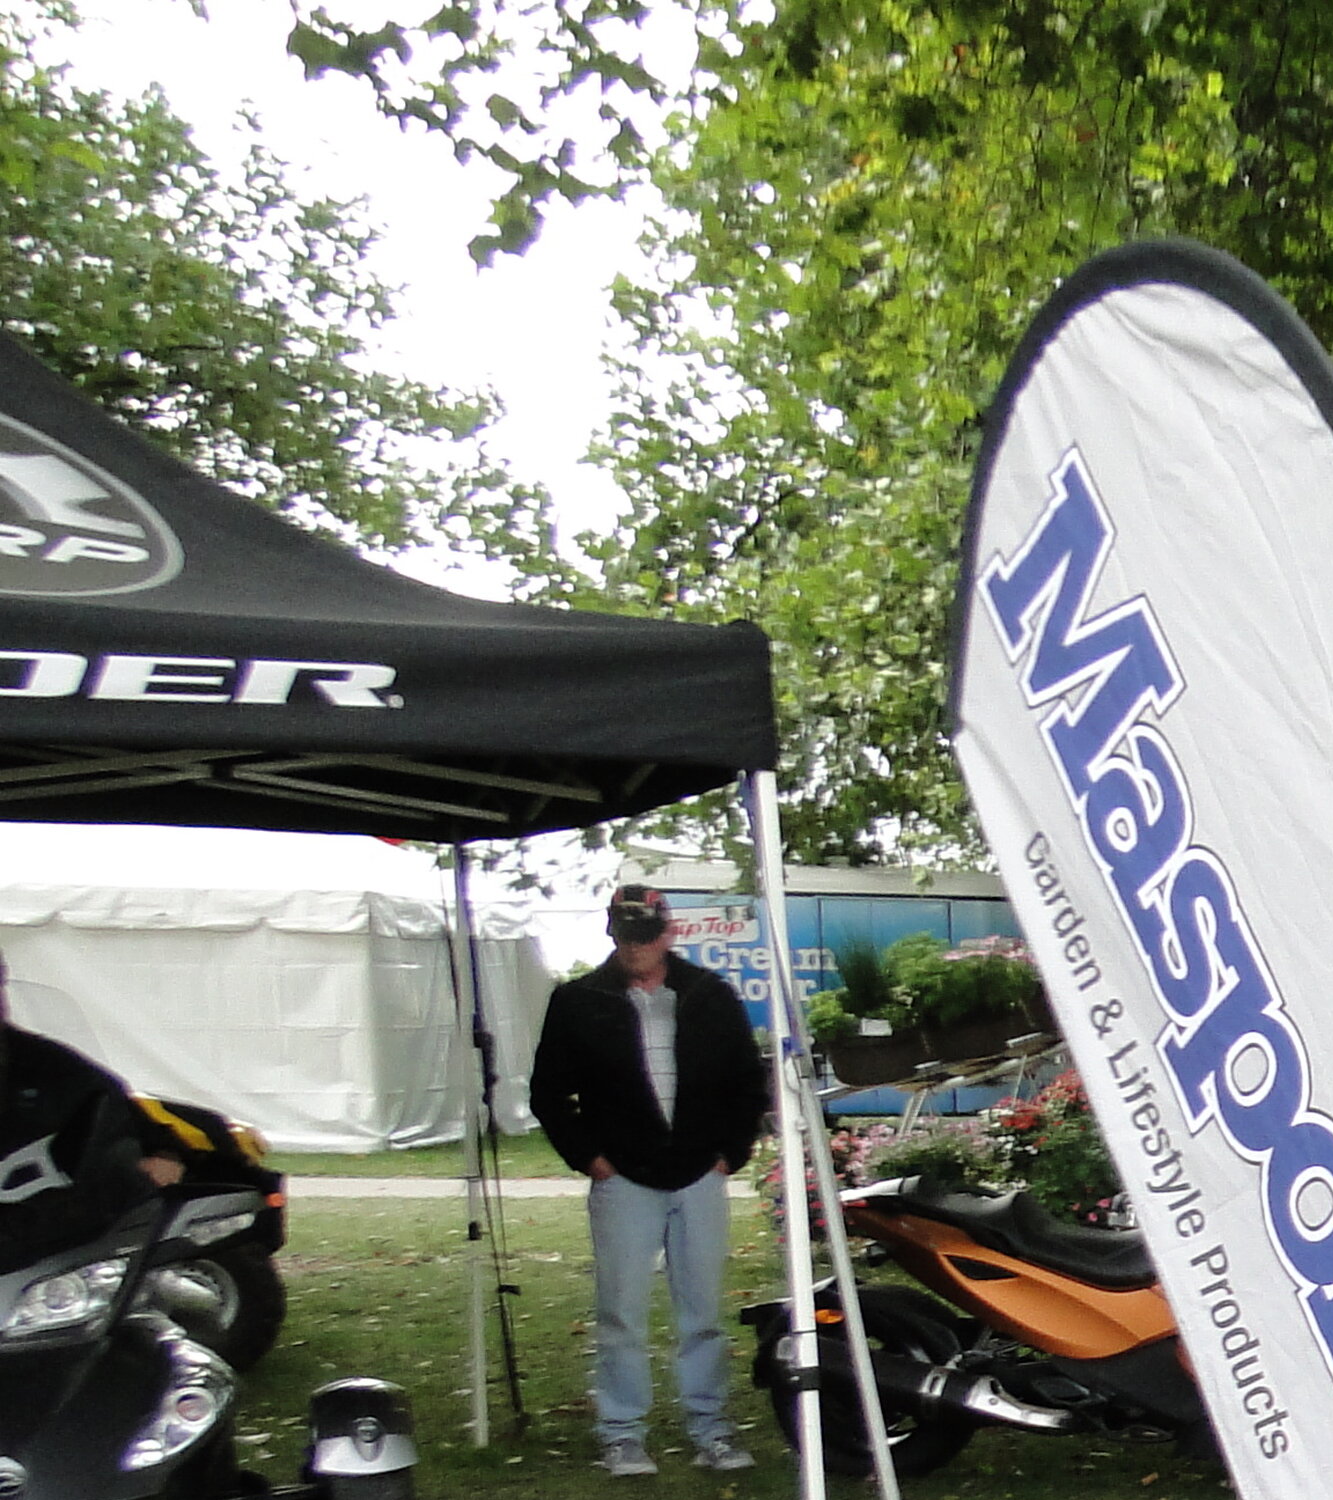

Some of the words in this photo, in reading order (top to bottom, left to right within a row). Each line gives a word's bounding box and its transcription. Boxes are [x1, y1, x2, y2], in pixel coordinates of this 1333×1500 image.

[701, 941, 839, 972] Crem
[1024, 830, 1102, 993] Garden
[1088, 998, 1126, 1039] &
[1107, 1039, 1206, 1239] Lifestyle
[1189, 1243, 1291, 1463] Products
